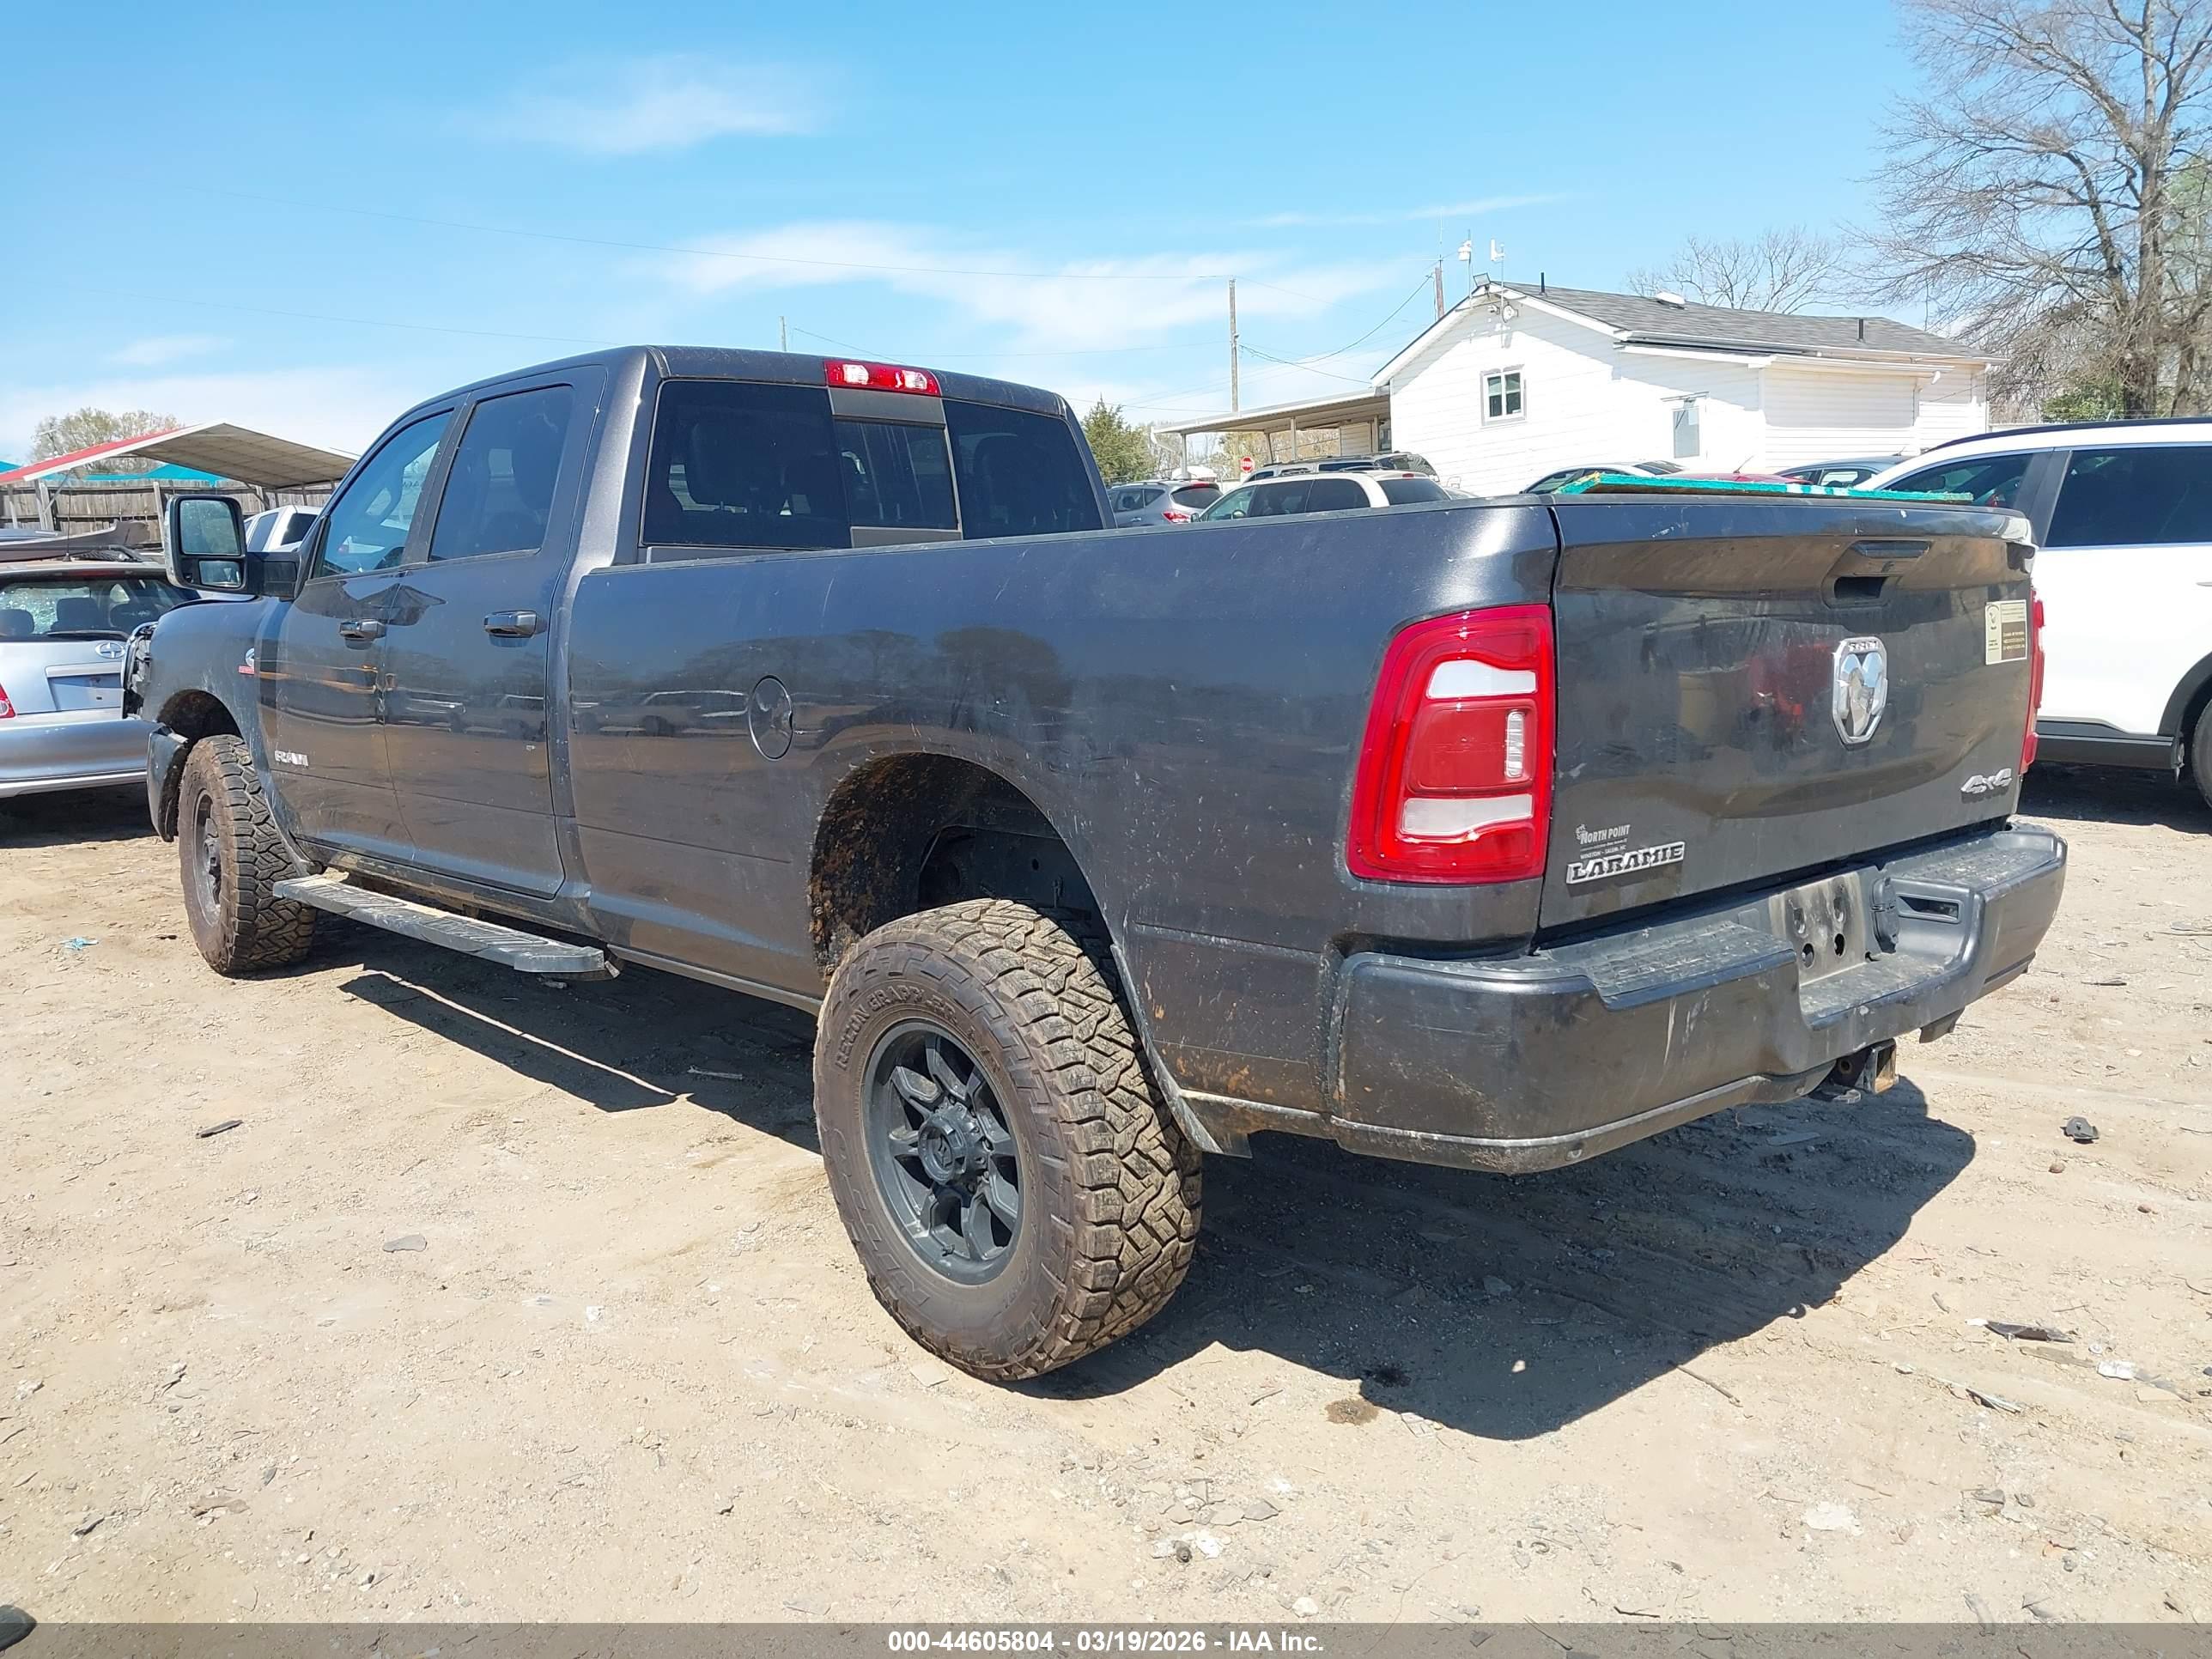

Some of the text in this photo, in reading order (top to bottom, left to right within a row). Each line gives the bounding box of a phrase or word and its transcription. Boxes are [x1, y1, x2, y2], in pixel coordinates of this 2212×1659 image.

[1580, 829, 1607, 845] NORTH
[1607, 824, 1631, 839] POINT
[1569, 842, 1685, 882] LARAMIE
[836, 1005, 870, 1072] RECON
